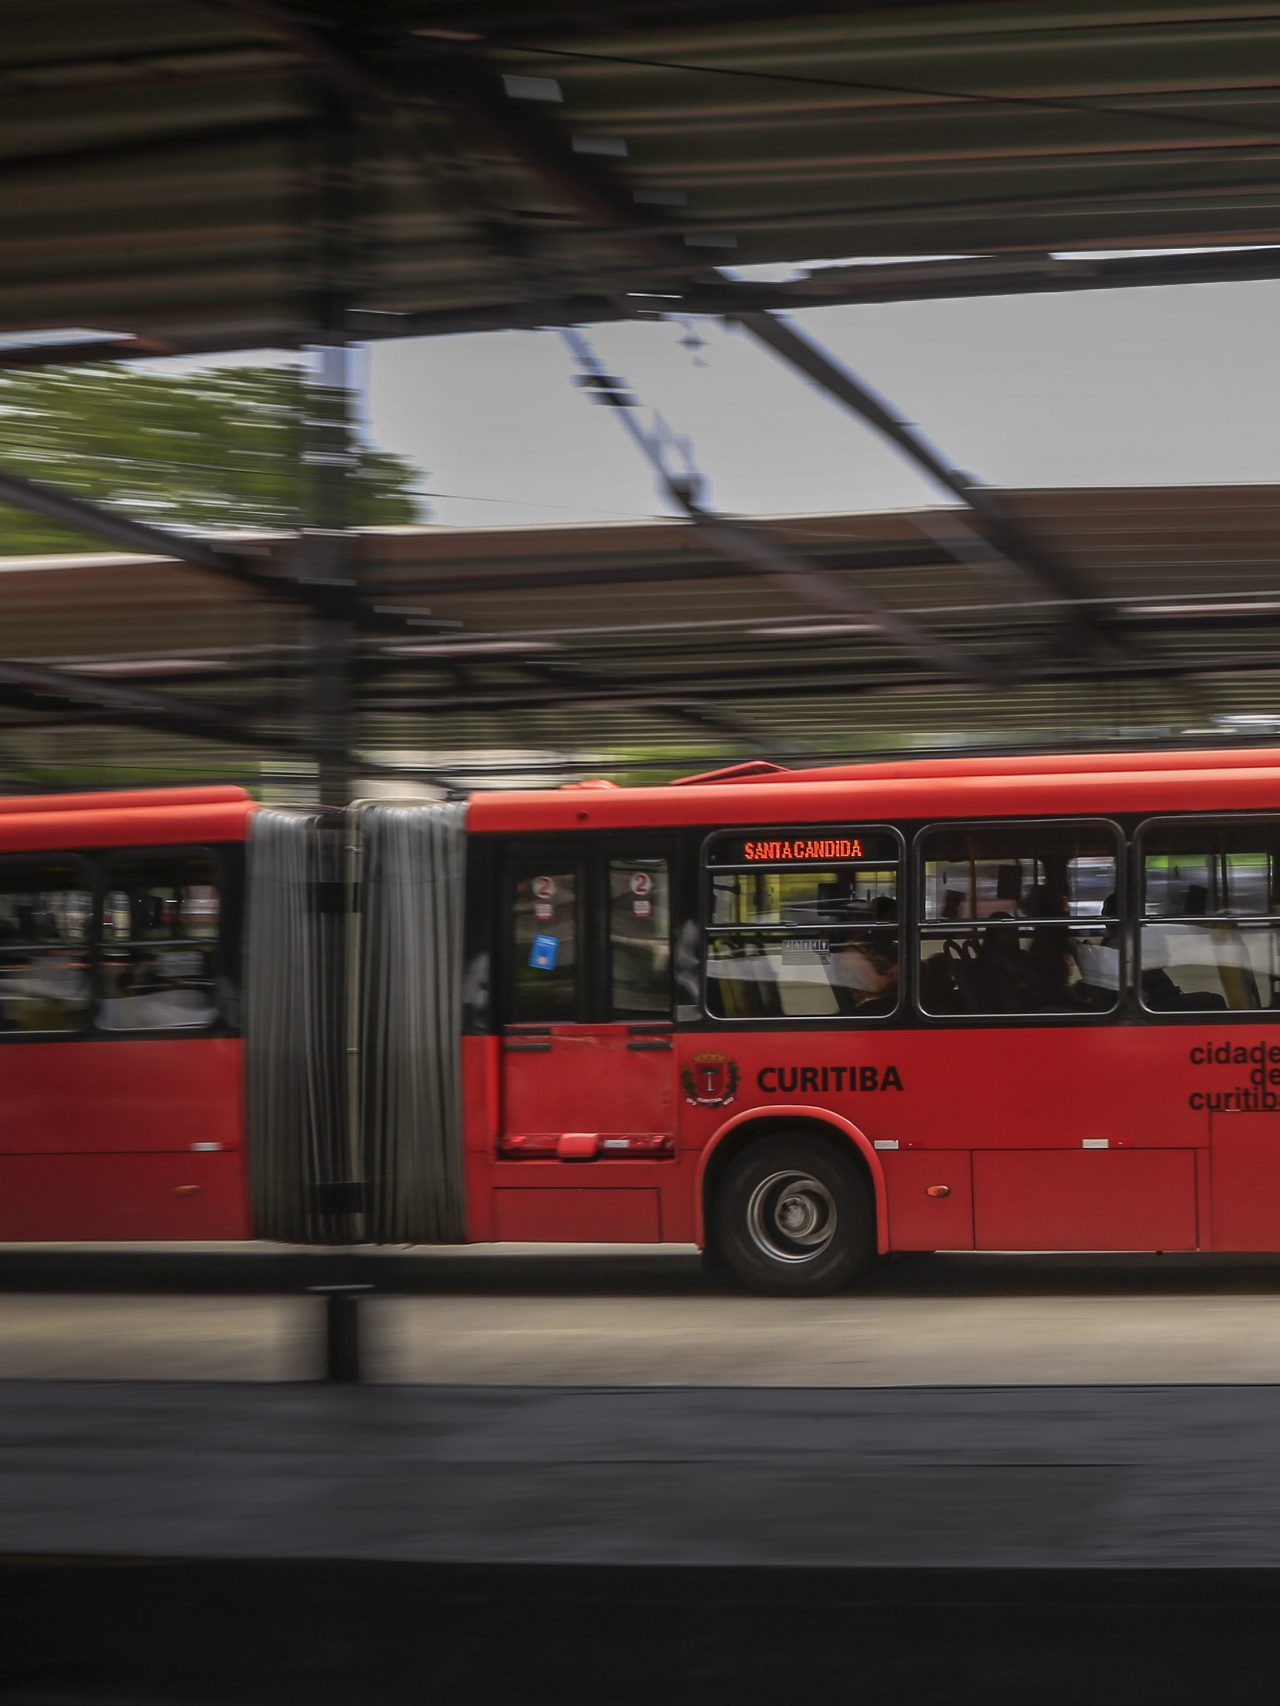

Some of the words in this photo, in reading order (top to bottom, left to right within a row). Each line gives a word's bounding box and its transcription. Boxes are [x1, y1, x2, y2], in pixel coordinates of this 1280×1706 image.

[744, 841, 793, 860] SANTA
[794, 840, 862, 858] CANDIDA
[537, 877, 551, 896] 2
[634, 874, 648, 892] 2
[757, 1065, 904, 1093] CURITIBA
